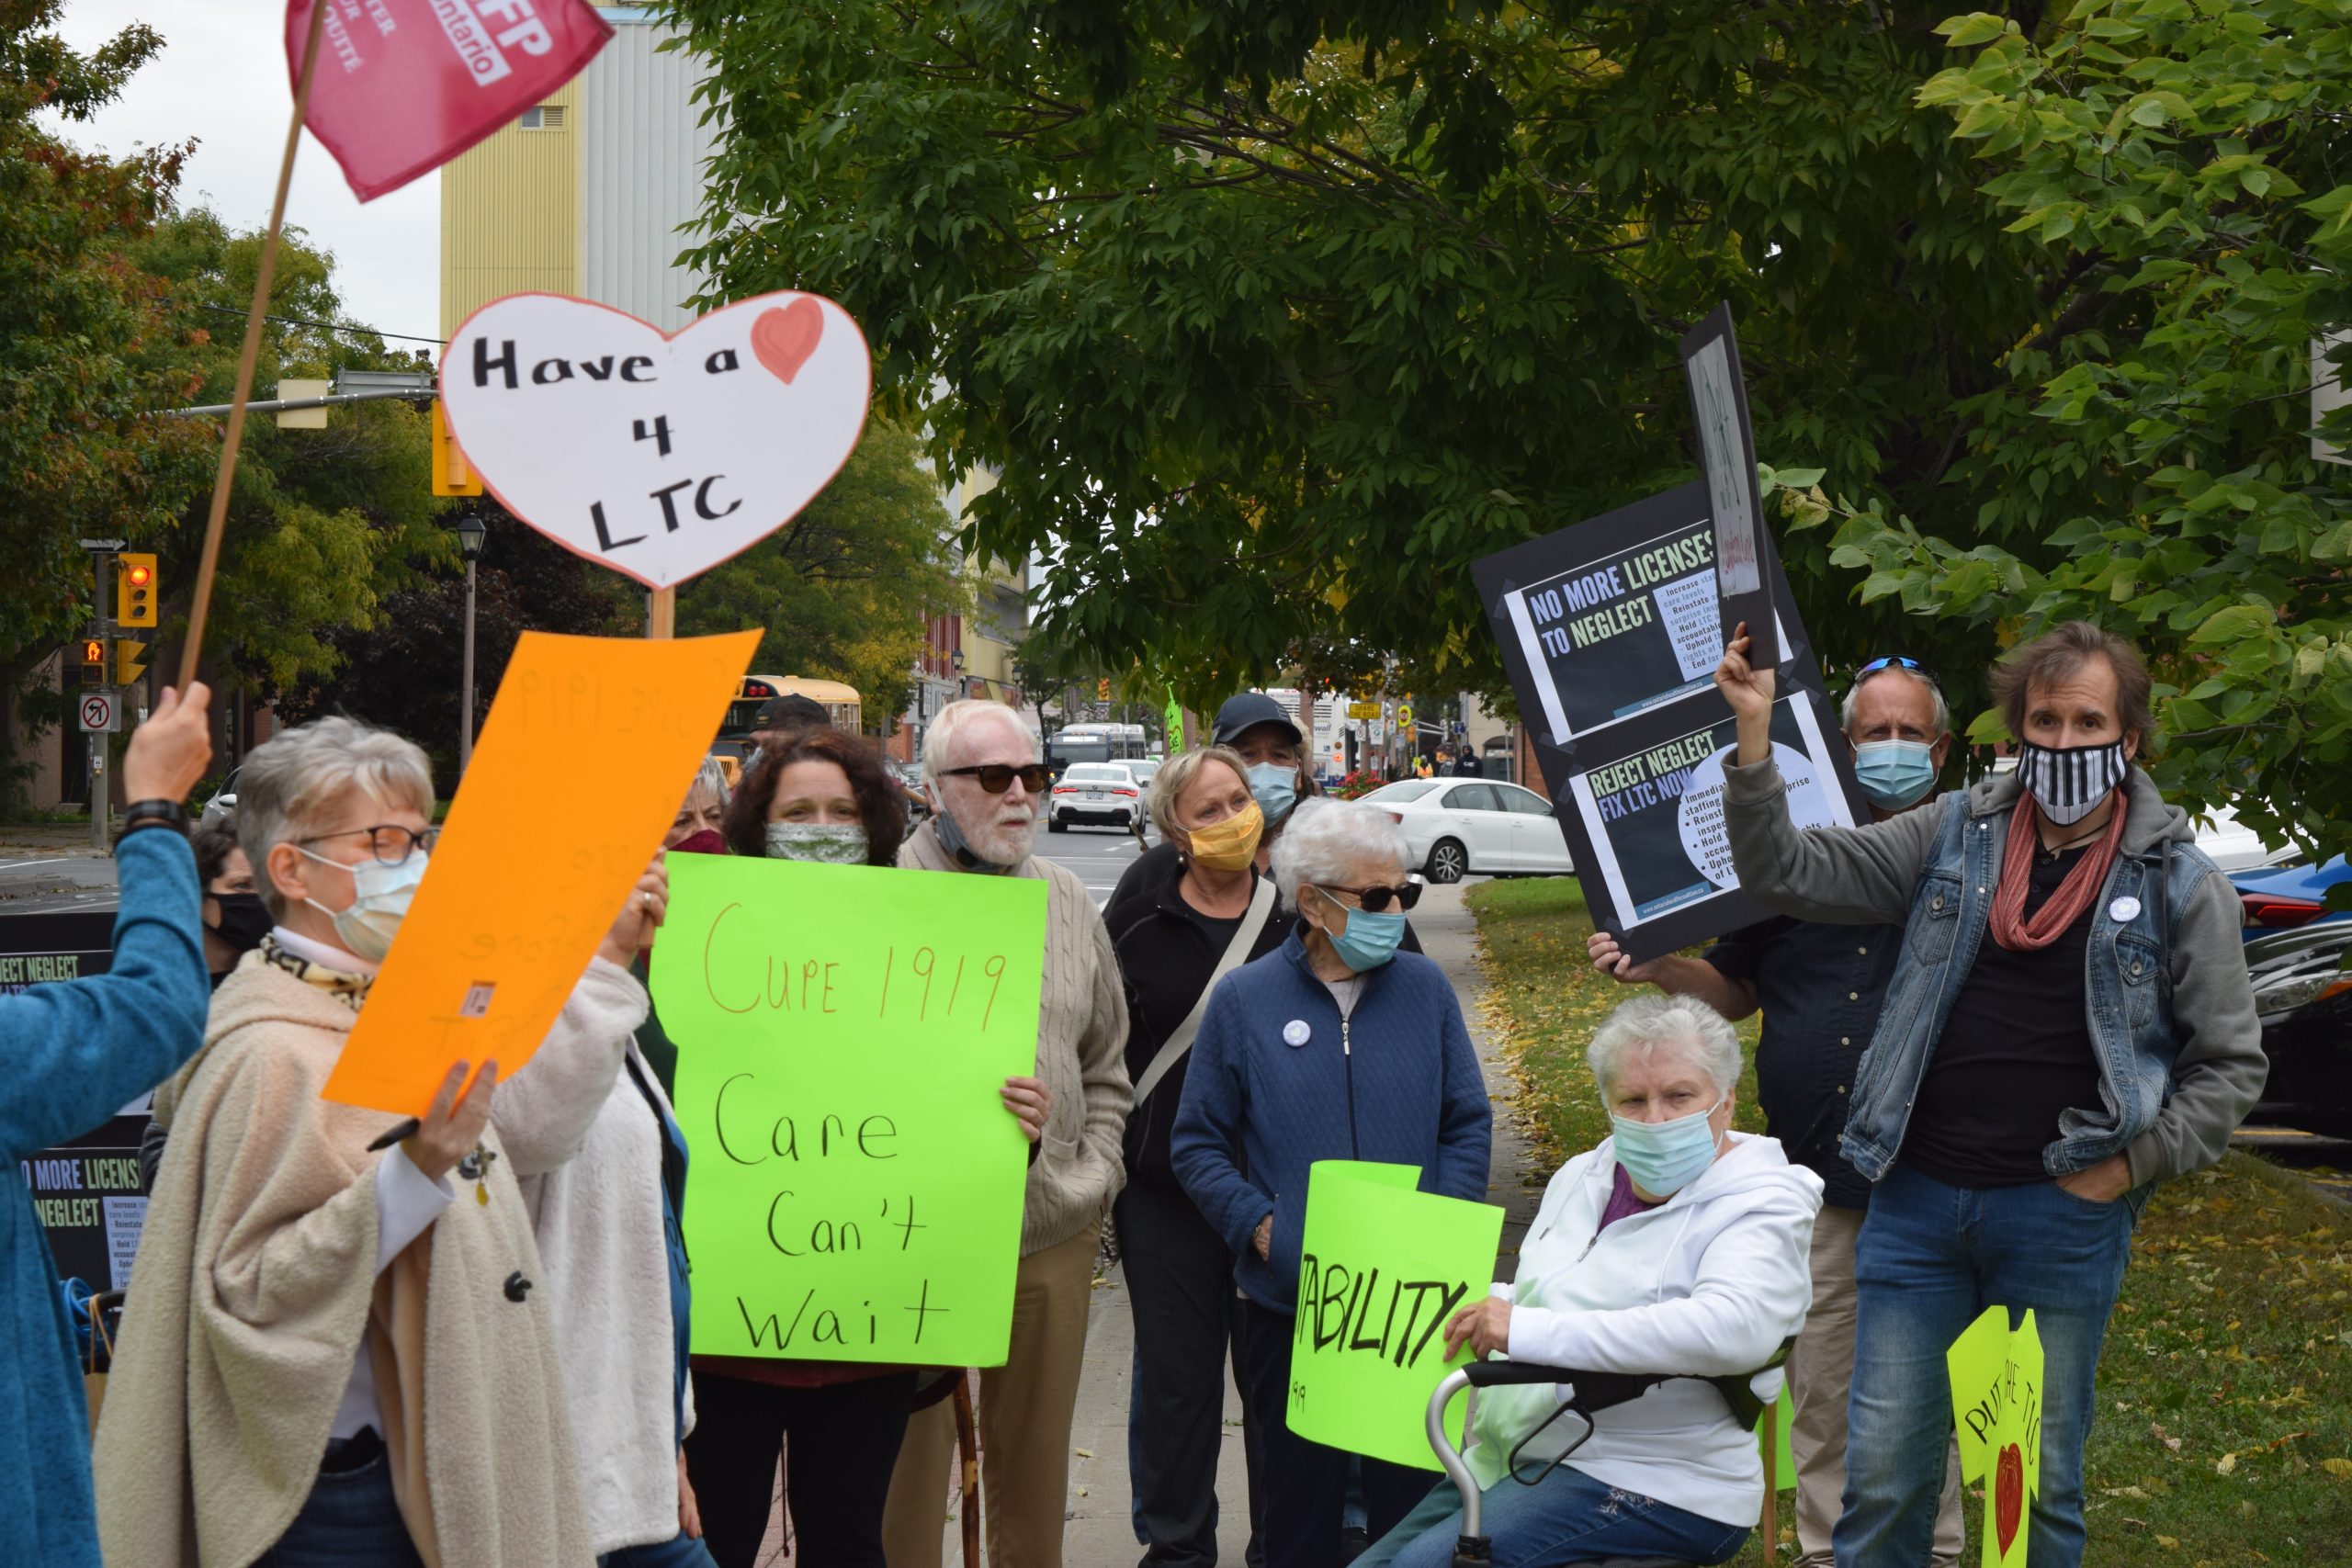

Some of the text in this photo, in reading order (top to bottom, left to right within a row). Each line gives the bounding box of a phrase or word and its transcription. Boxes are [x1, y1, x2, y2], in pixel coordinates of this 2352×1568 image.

[472, 336, 741, 389] Have a
[631, 413, 675, 458] 4
[590, 474, 743, 553] LTC
[1529, 589, 1564, 626] NO
[1563, 566, 1626, 613] MORE
[1663, 598, 1681, 608] care
[1681, 588, 1705, 601] levels
[1666, 580, 1699, 597] Increase
[1670, 609, 1702, 626] surprise
[1672, 596, 1710, 615] Reinstate
[1542, 595, 1653, 659] TO NEGLECT
[1679, 621, 1698, 634] Hold
[1683, 649, 1707, 663] rights
[1685, 636, 1713, 652] Uphold
[1692, 658, 1707, 671] End
[1589, 730, 1715, 798] REJECT NEGLECT
[1598, 766, 1693, 822] FIX LTC NOW
[1685, 797, 1722, 817] staffing
[1701, 832, 1723, 848] Hold
[1714, 868, 1724, 880] of
[26, 955, 79, 982] NEGLECT
[879, 944, 1007, 1032] 1919
[715, 1072, 899, 1166] Care
[34, 1159, 84, 1190] MORE
[84, 1157, 141, 1190] LICENS
[34, 1198, 100, 1227] NEGLECT
[766, 1190, 929, 1258] Can't
[737, 1278, 951, 1350] Wait
[1964, 1374, 2002, 1445] PUT
